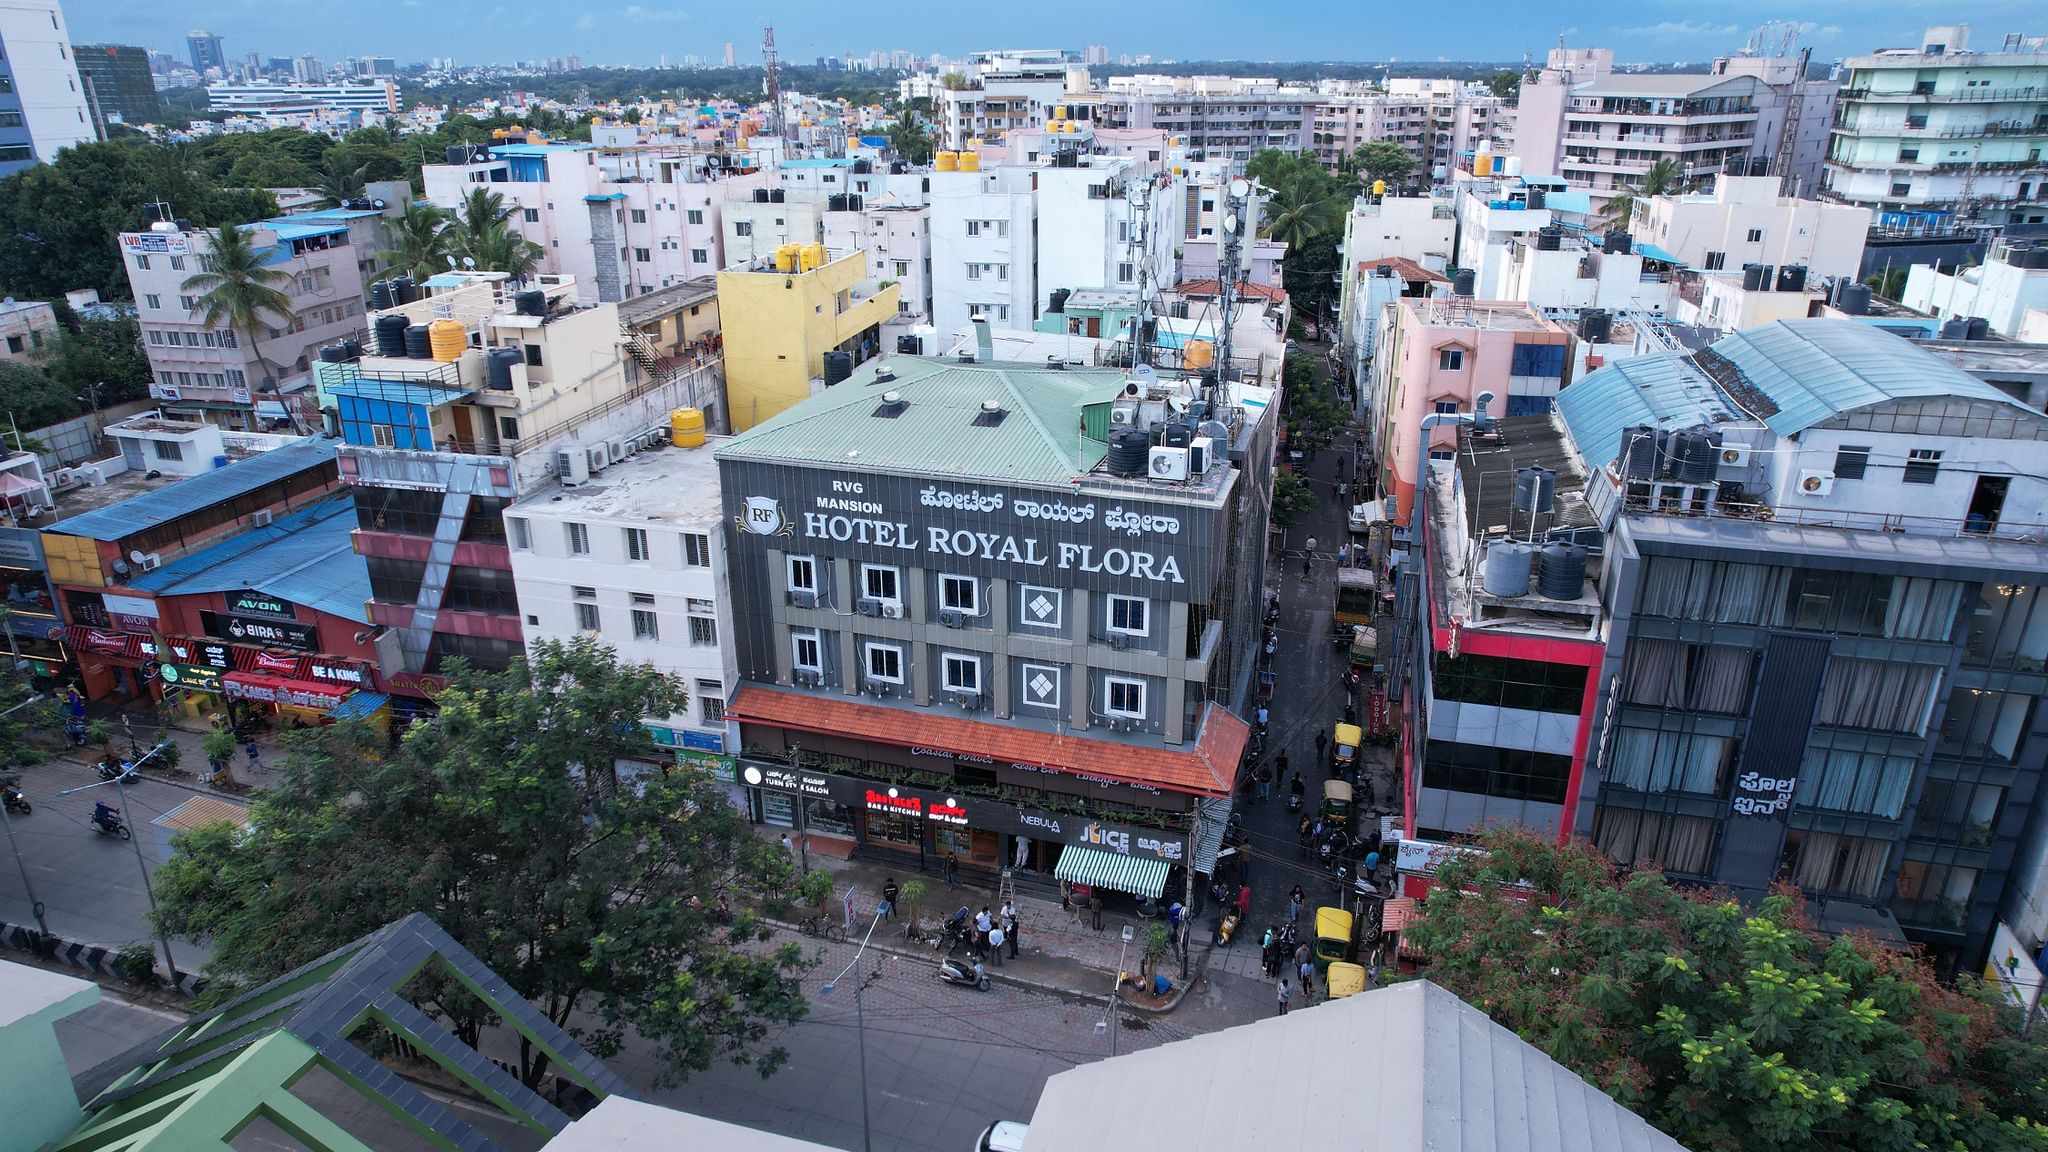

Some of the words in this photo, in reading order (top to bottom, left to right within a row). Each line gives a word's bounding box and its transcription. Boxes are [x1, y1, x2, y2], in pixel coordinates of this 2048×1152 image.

[124, 236, 141, 246] LVR
[833, 480, 863, 494] RVG
[817, 496, 883, 514] MANSION
[920, 485, 1004, 513] ಹೋಟೆಲ್
[1014, 500, 1094, 523] ರಾಯಲ್
[1105, 505, 1180, 537] ಫ್ಲೋರಾ
[752, 507, 774, 523] RF
[804, 512, 919, 550] HOTEL
[927, 527, 1048, 567] ROYAL
[1057, 542, 1185, 584] FLORA
[237, 599, 282, 612] AVON
[122, 615, 149, 626] AVON
[246, 624, 276, 639] BIRA
[88, 634, 126, 647] Budweiser
[140, 642, 154, 654] BE
[257, 656, 298, 670] Budweiser
[311, 665, 326, 678] BE
[328, 667, 334, 678] A
[336, 668, 362, 683] KING
[765, 778, 784, 787] TURN
[785, 781, 805, 791] STYE
[805, 785, 829, 795] SALON
[867, 802, 881, 810] BAR
[890, 805, 921, 817] KITCHEN
[1733, 797, 1788, 815] ಇನ್
[1020, 814, 1060, 829] NEBULA
[1080, 825, 1129, 847] JUICE
